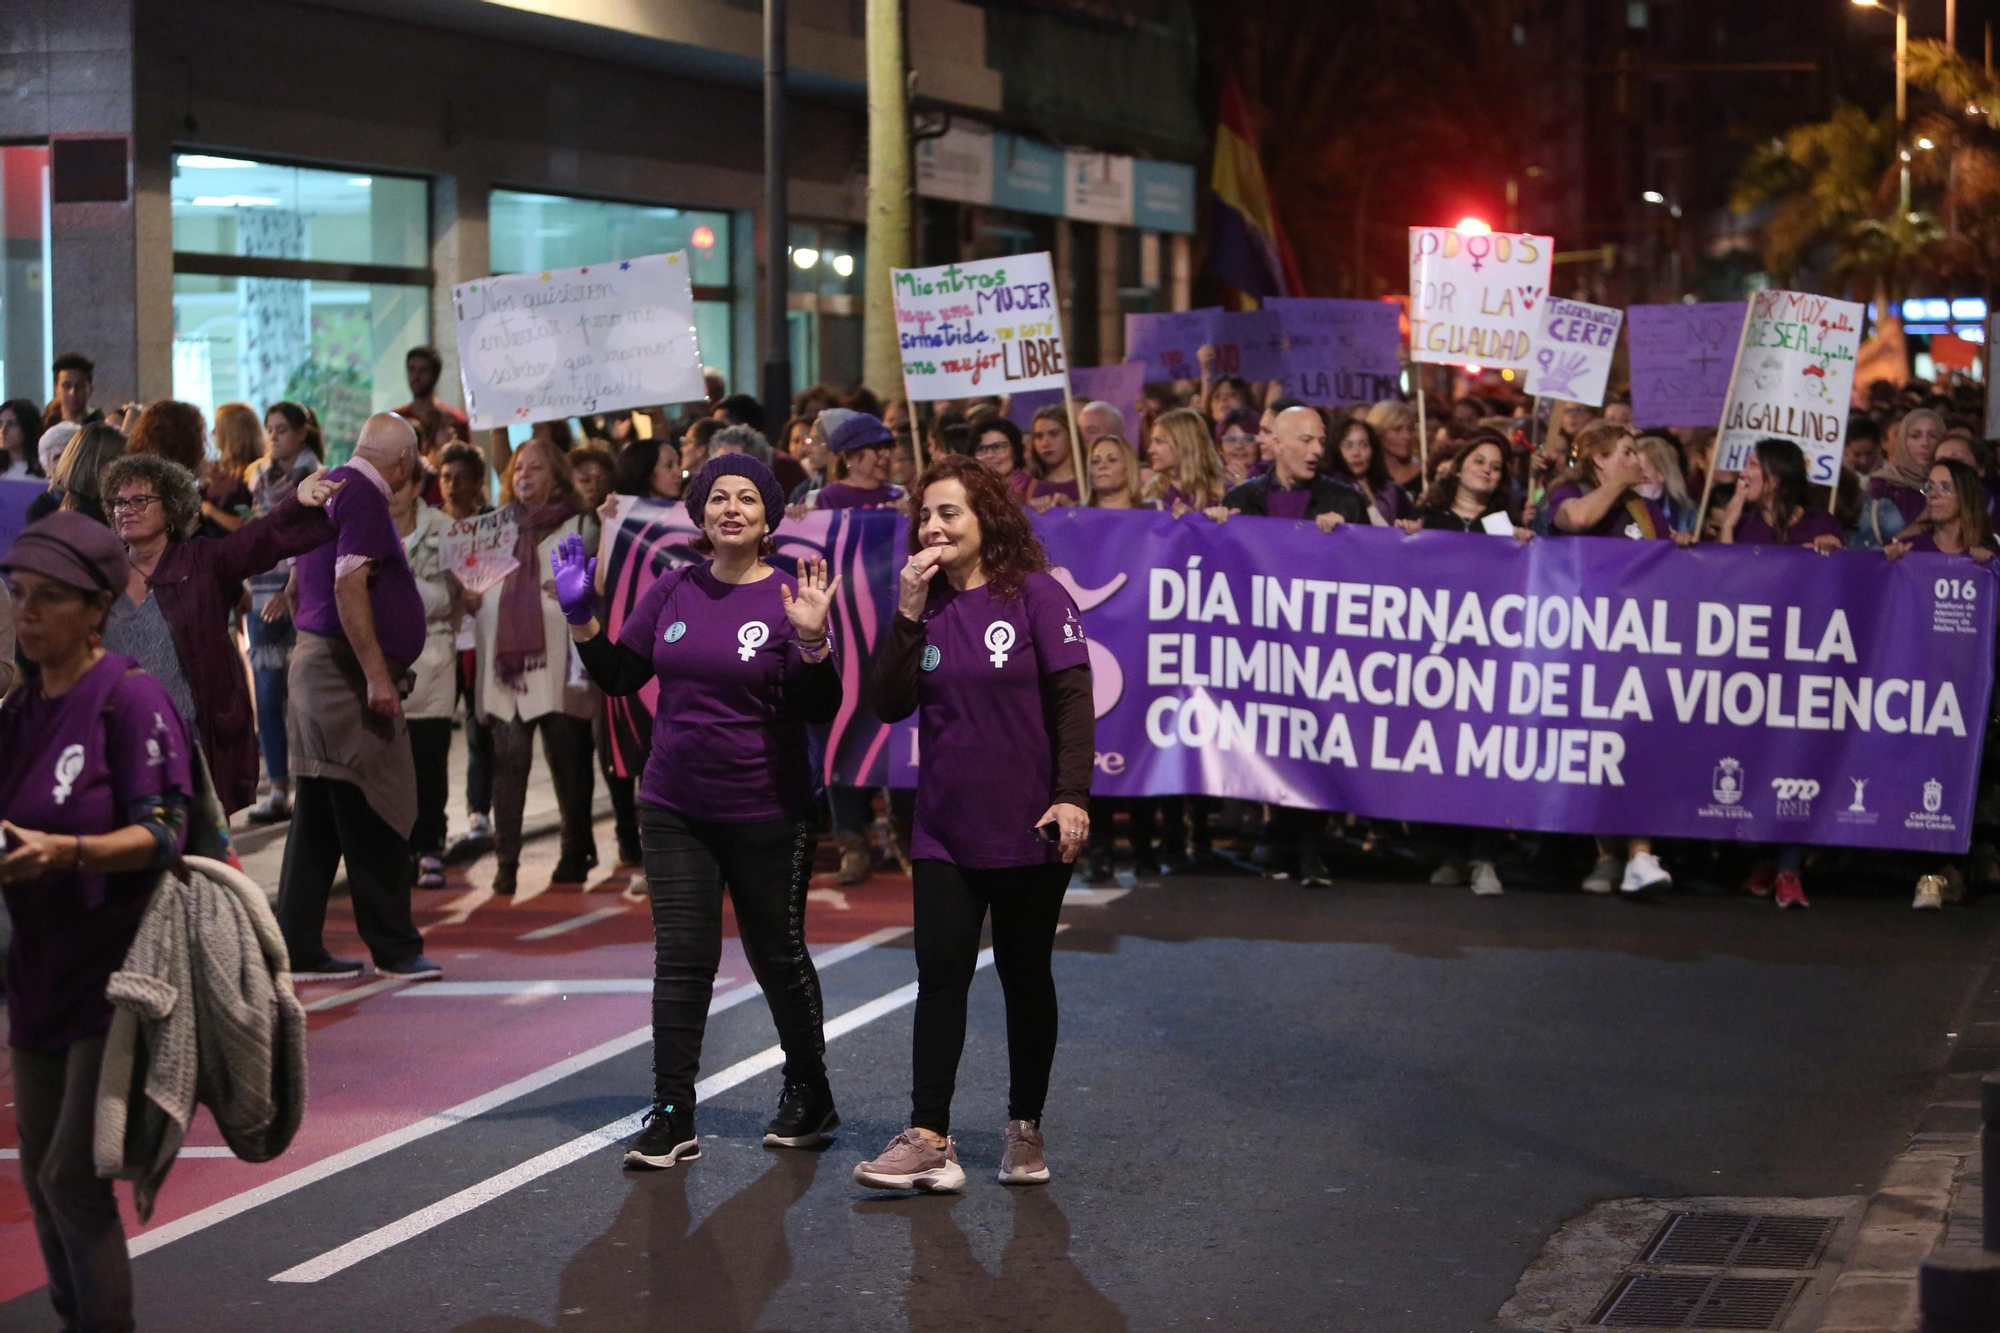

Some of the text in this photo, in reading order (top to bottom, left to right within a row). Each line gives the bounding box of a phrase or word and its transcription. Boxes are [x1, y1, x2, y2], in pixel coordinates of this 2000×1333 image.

[895, 263, 1006, 296] Mientras
[977, 282, 1051, 314] MUJER
[1480, 286, 1515, 317] LA
[1410, 318, 1530, 361] IGUALDAD
[1548, 317, 1613, 347] CERO
[941, 349, 1001, 385] mujer
[1002, 337, 1064, 381] LIBRE
[1934, 578, 1977, 600] 016
[1148, 555, 1858, 664] DÍA INTERNACIONAL DE LA
[1147, 633, 1497, 713] ELIMINACIÓN
[1508, 661, 1569, 717] DE
[1580, 663, 1654, 722] LA
[1666, 668, 1967, 737] VIOLENCIA
[1145, 695, 1358, 769] CONTRA
[1371, 716, 1444, 775] LA
[1455, 722, 1626, 787] MUJER
